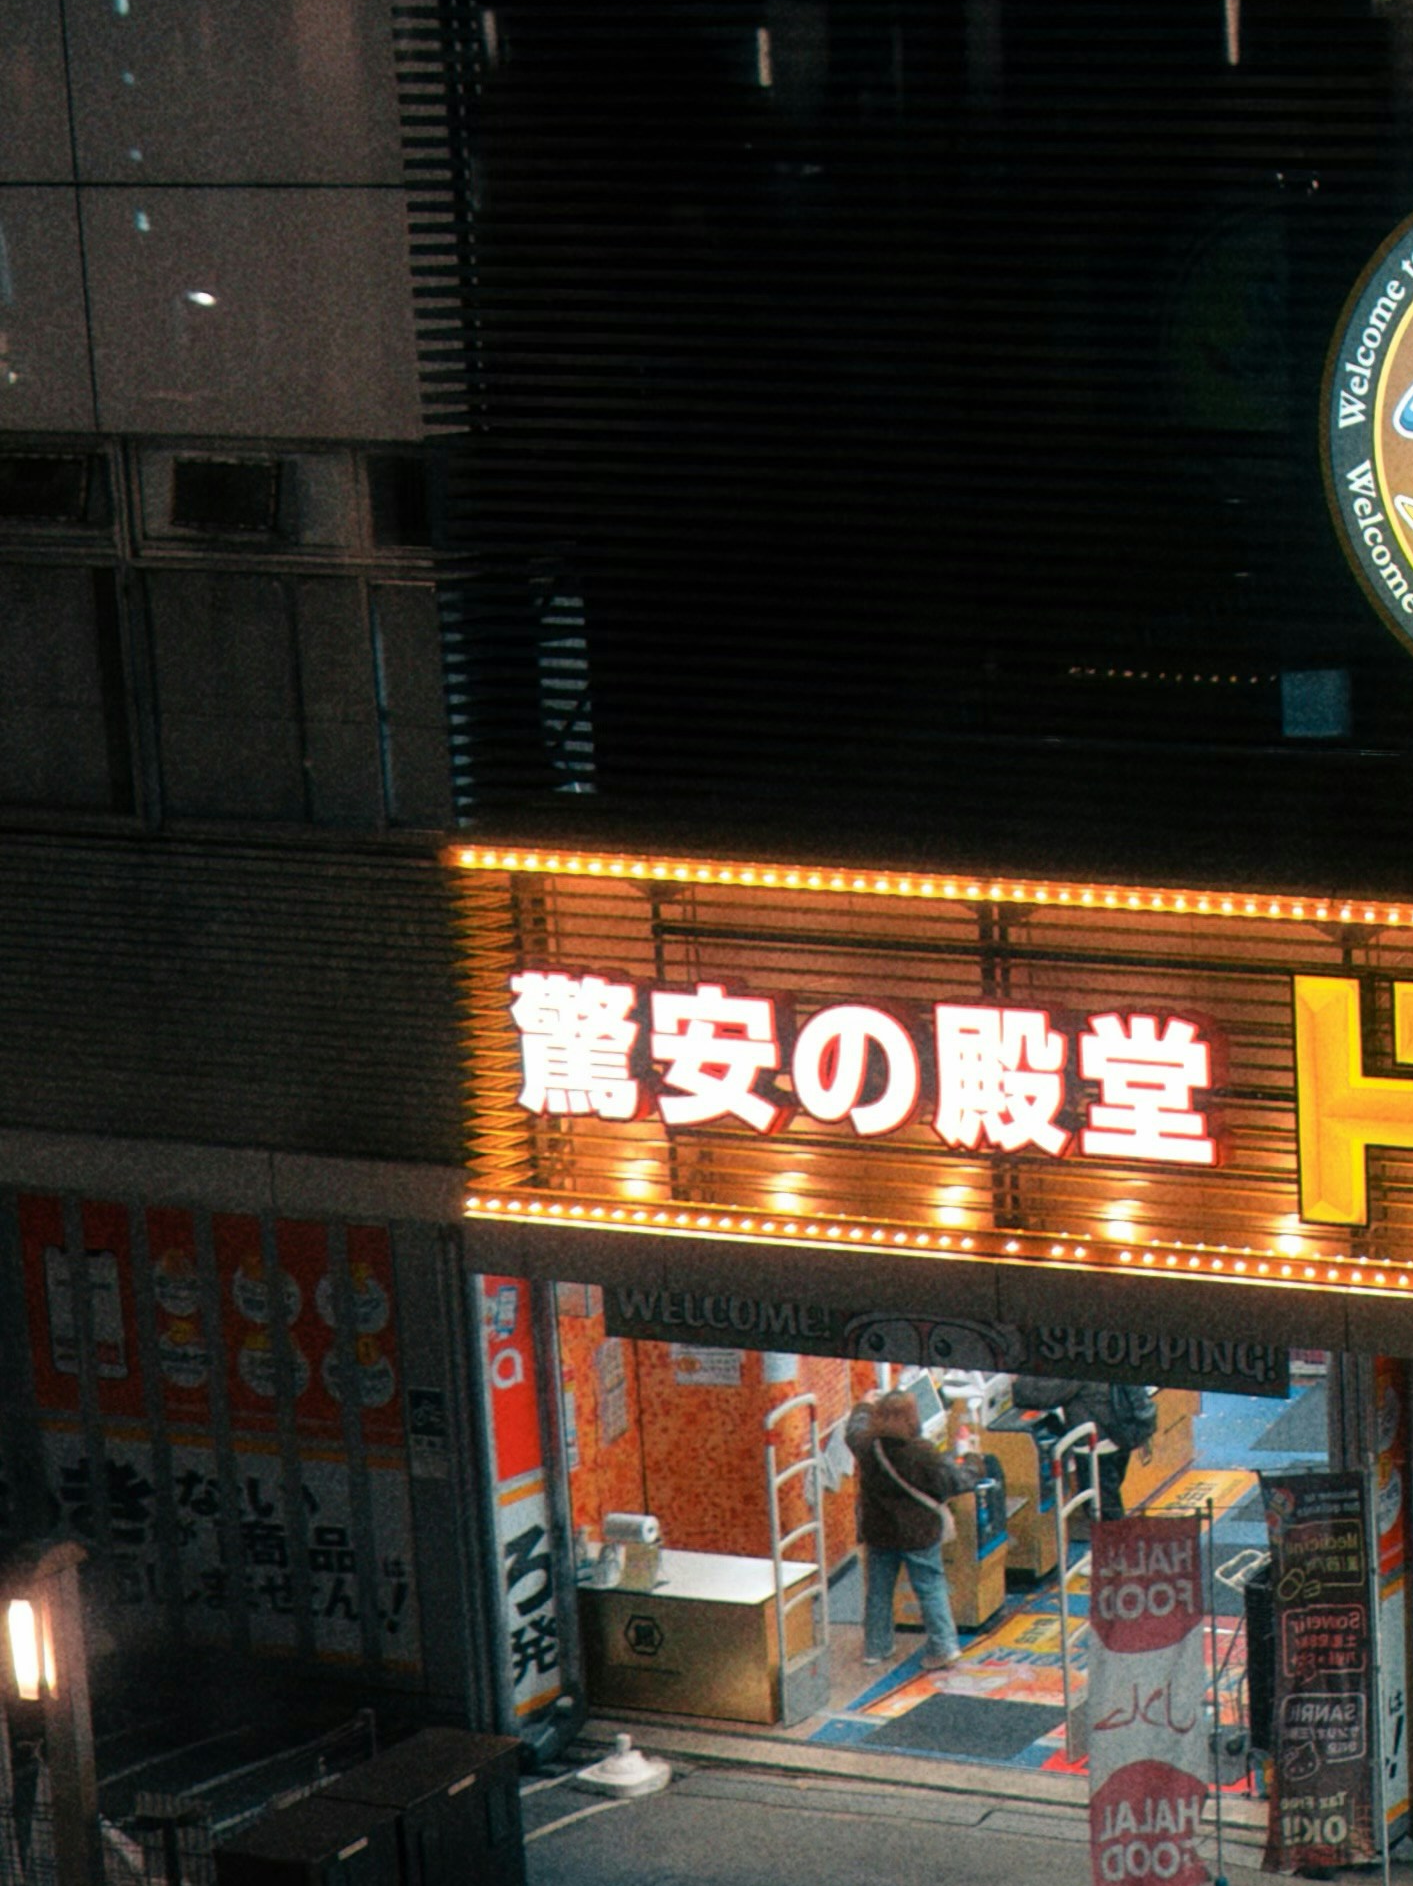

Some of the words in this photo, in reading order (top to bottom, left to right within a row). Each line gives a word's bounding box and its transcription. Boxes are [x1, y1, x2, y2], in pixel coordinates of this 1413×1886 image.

[1339, 279, 1407, 429] Welcome
[509, 969, 1218, 1166] 驚安の殿堂
[618, 1287, 831, 1340] WELCOME!
[1037, 1323, 1280, 1380] SHOPPING!
